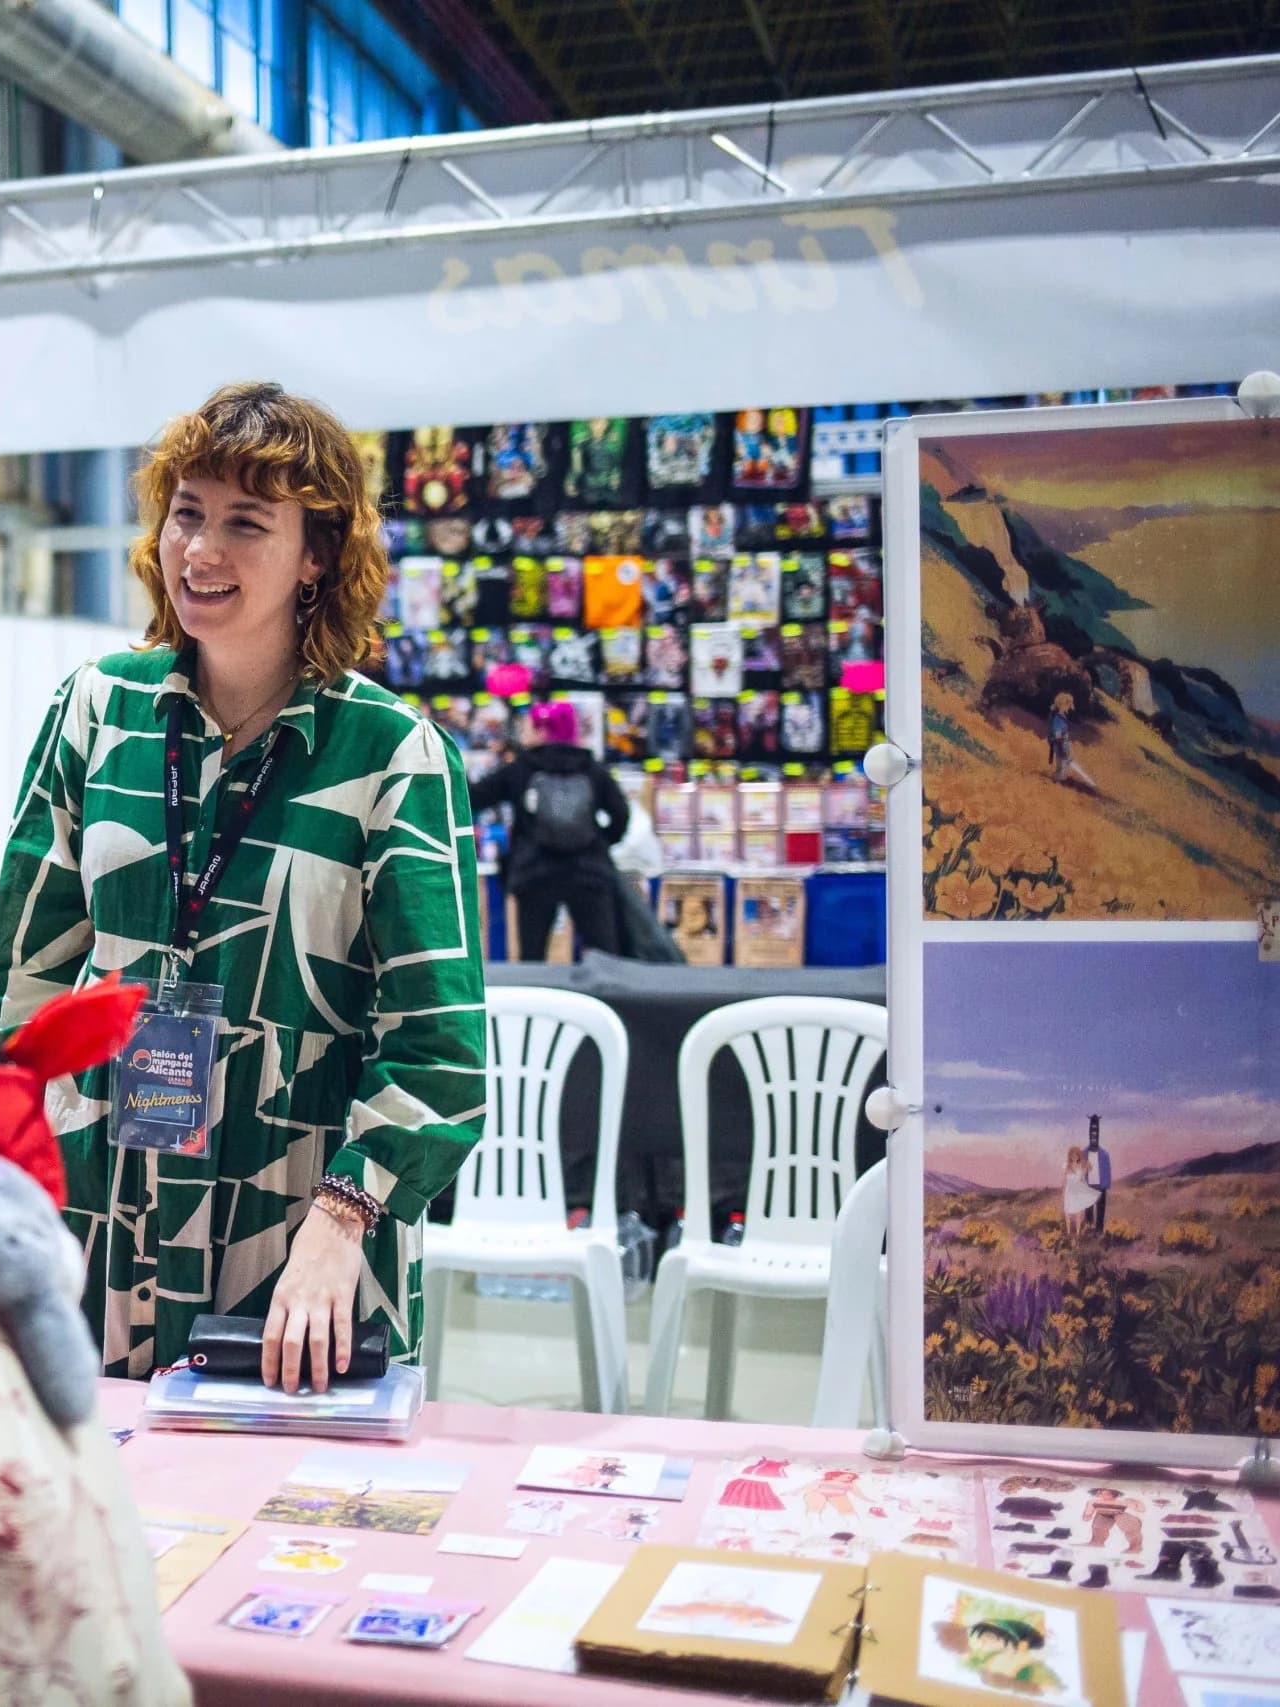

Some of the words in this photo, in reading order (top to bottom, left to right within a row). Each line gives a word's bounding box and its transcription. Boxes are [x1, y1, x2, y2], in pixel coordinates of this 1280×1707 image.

[170, 765, 178, 807] JAPAN
[250, 757, 273, 796] JAPAN
[198, 855, 221, 896] JAPAN
[151, 1049, 176, 1059] Salón
[178, 1052, 193, 1061] del
[152, 1058, 181, 1068] manga
[182, 1061, 193, 1069] de
[146, 1065, 193, 1078] Alicante
